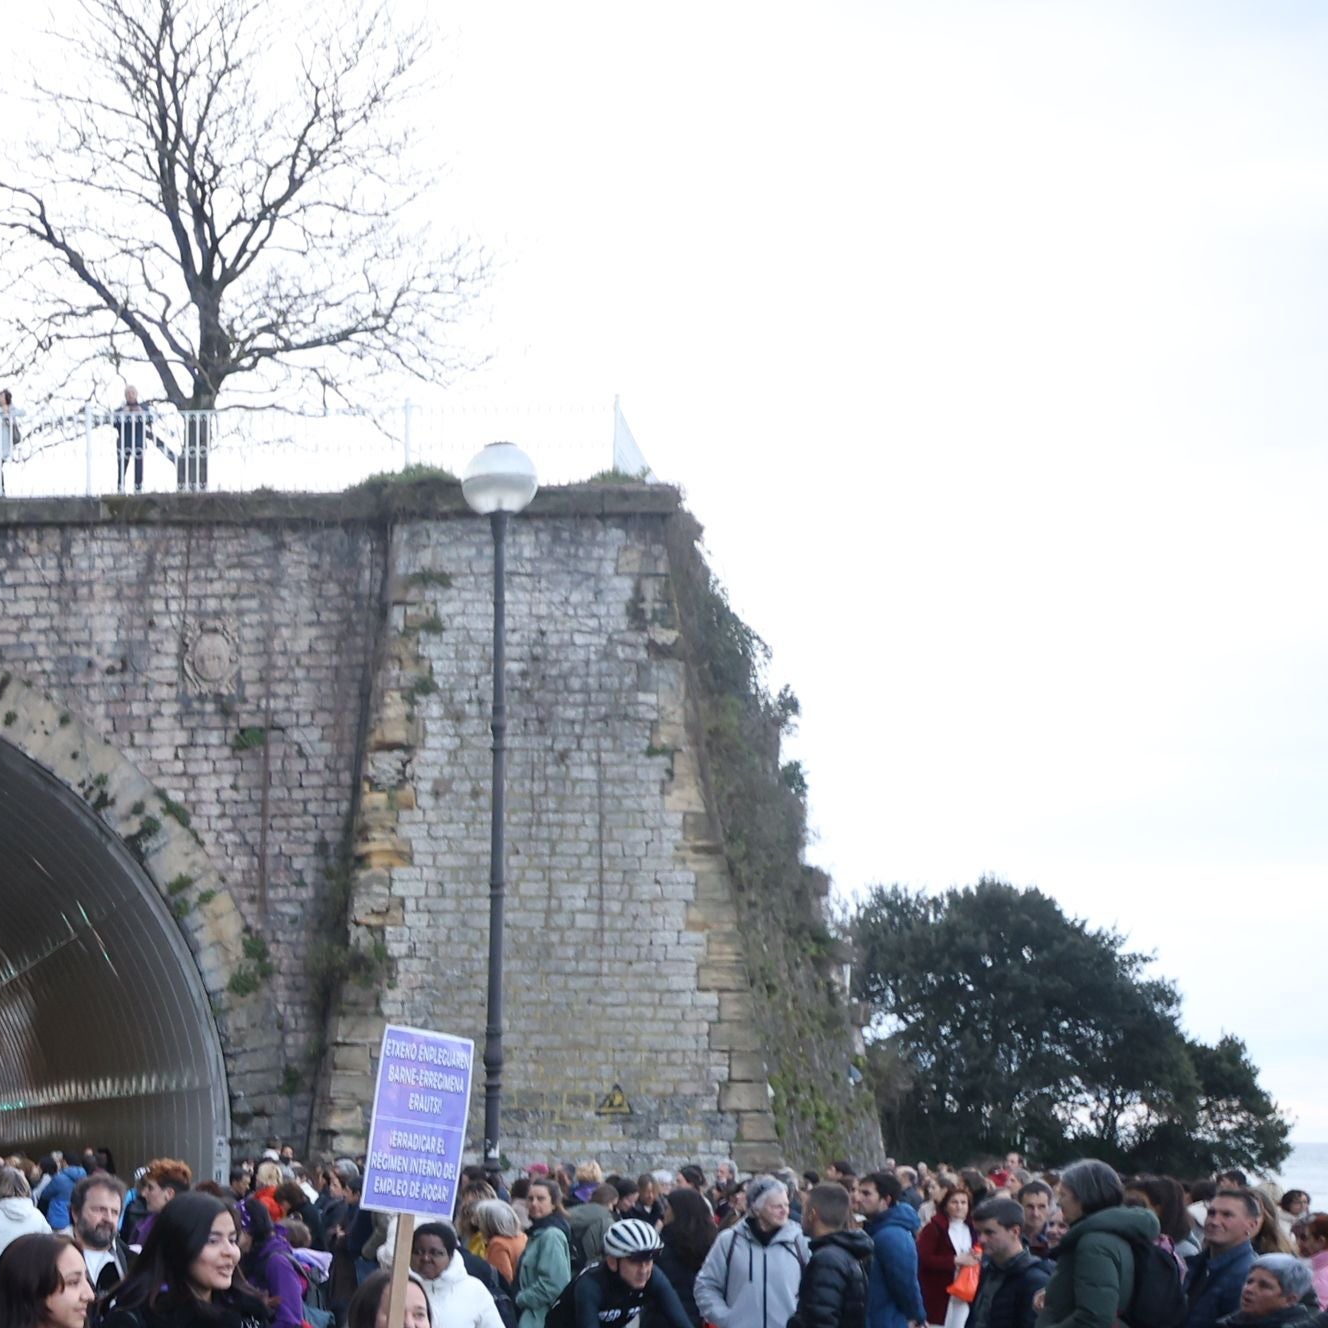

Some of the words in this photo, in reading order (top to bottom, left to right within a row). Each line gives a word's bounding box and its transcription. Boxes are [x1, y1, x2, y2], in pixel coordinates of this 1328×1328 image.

[385, 1039, 418, 1061] ETXEKO
[409, 1157, 443, 1178] INTERNO
[443, 1162, 456, 1180] DEL
[374, 1175, 408, 1197] EMPLEO
[409, 1180, 421, 1199] DE
